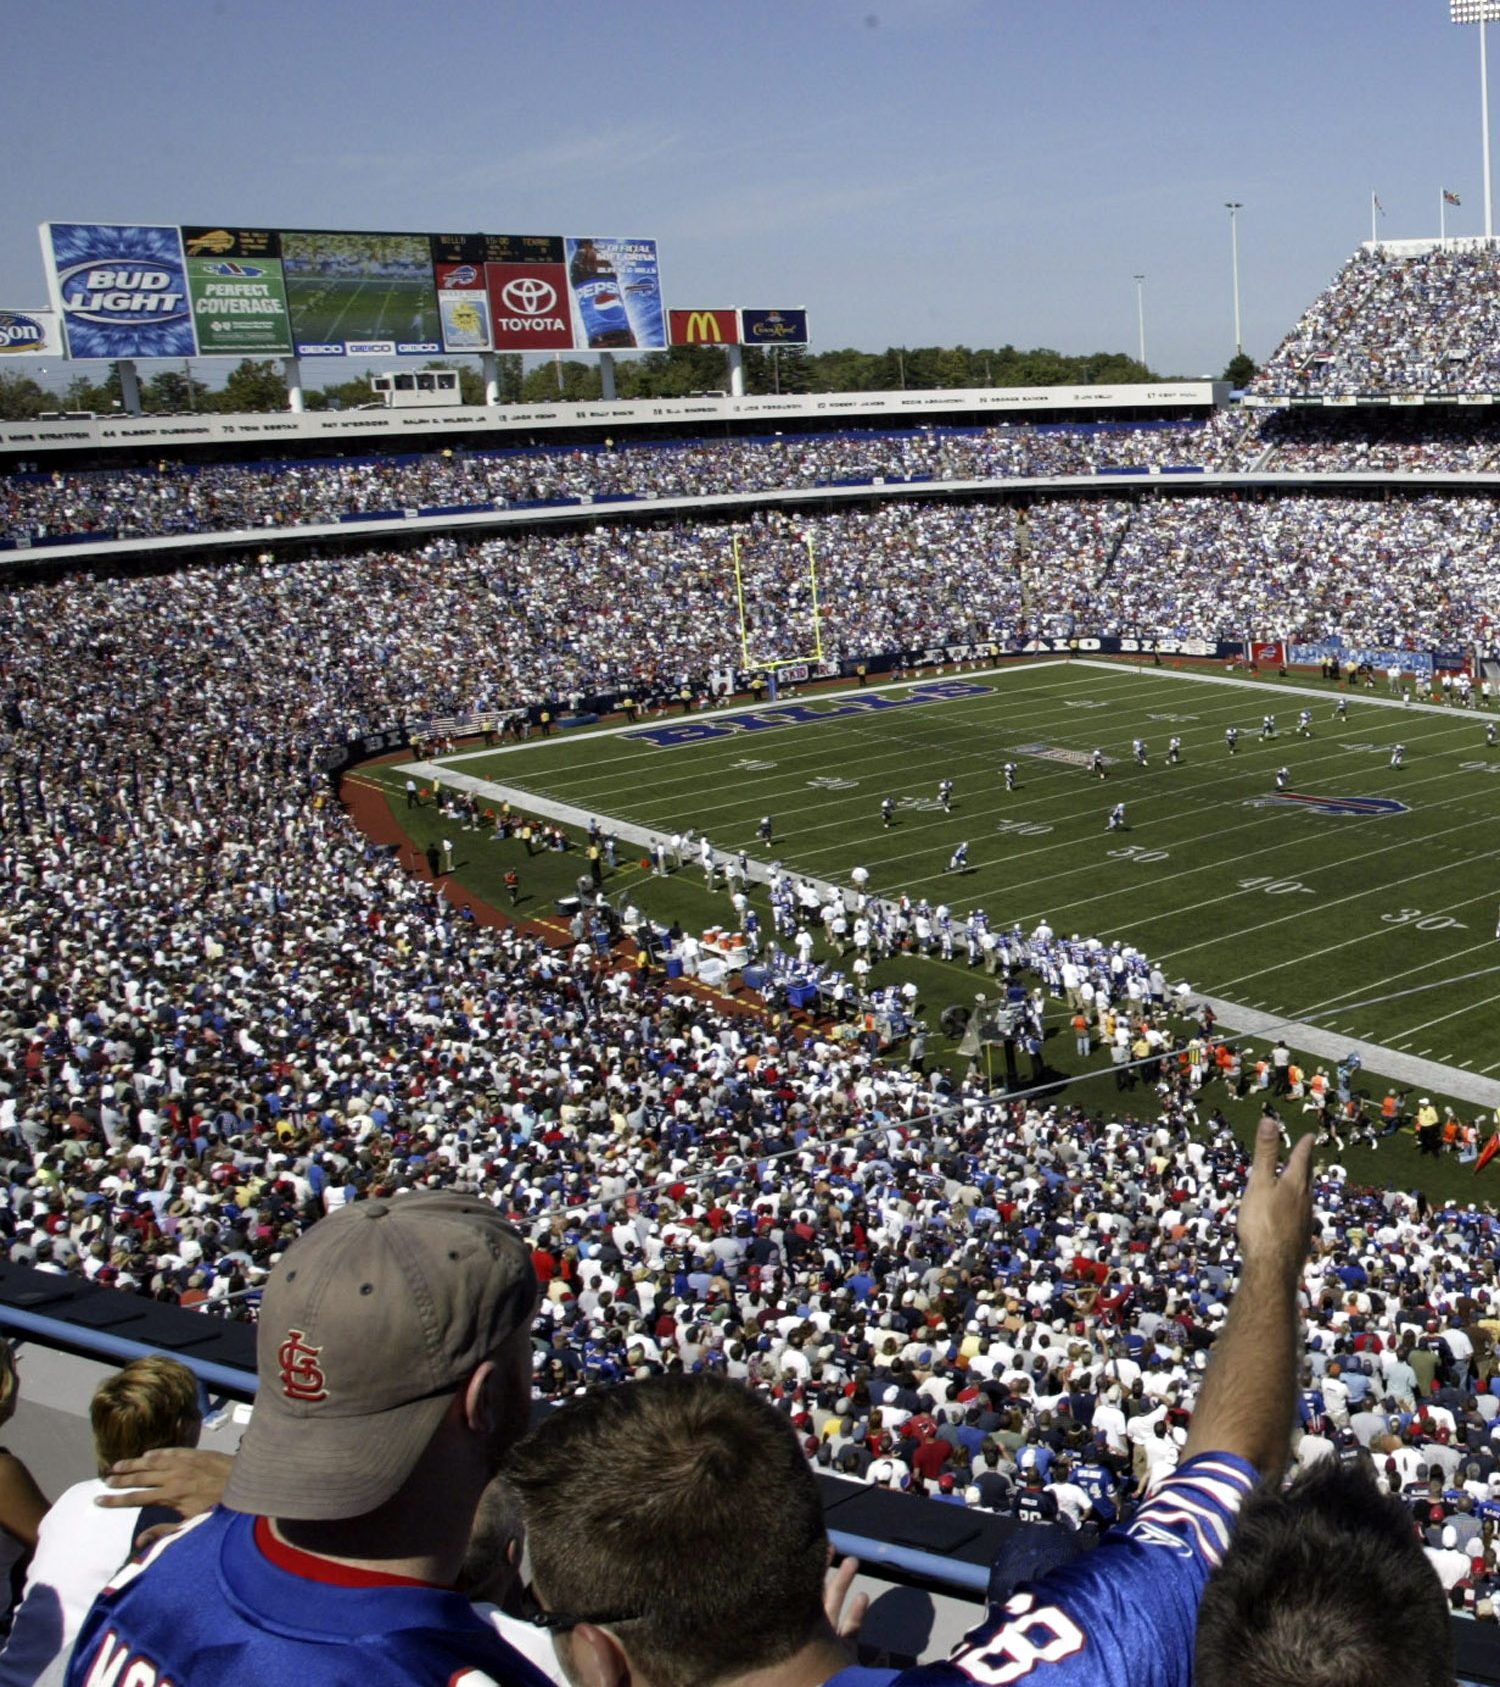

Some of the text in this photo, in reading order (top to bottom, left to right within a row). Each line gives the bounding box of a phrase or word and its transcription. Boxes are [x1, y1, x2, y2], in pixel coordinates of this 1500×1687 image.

[87, 271, 170, 290] BUD
[205, 284, 270, 297] PERFECT
[69, 292, 183, 312] LIGHT
[196, 299, 285, 314] COVERAGE
[499, 318, 565, 331] TOYOTA
[614, 681, 1000, 748] BILLS
[1106, 846, 1170, 863] 50
[1237, 876, 1303, 894] 40
[1381, 908, 1457, 931] 30
